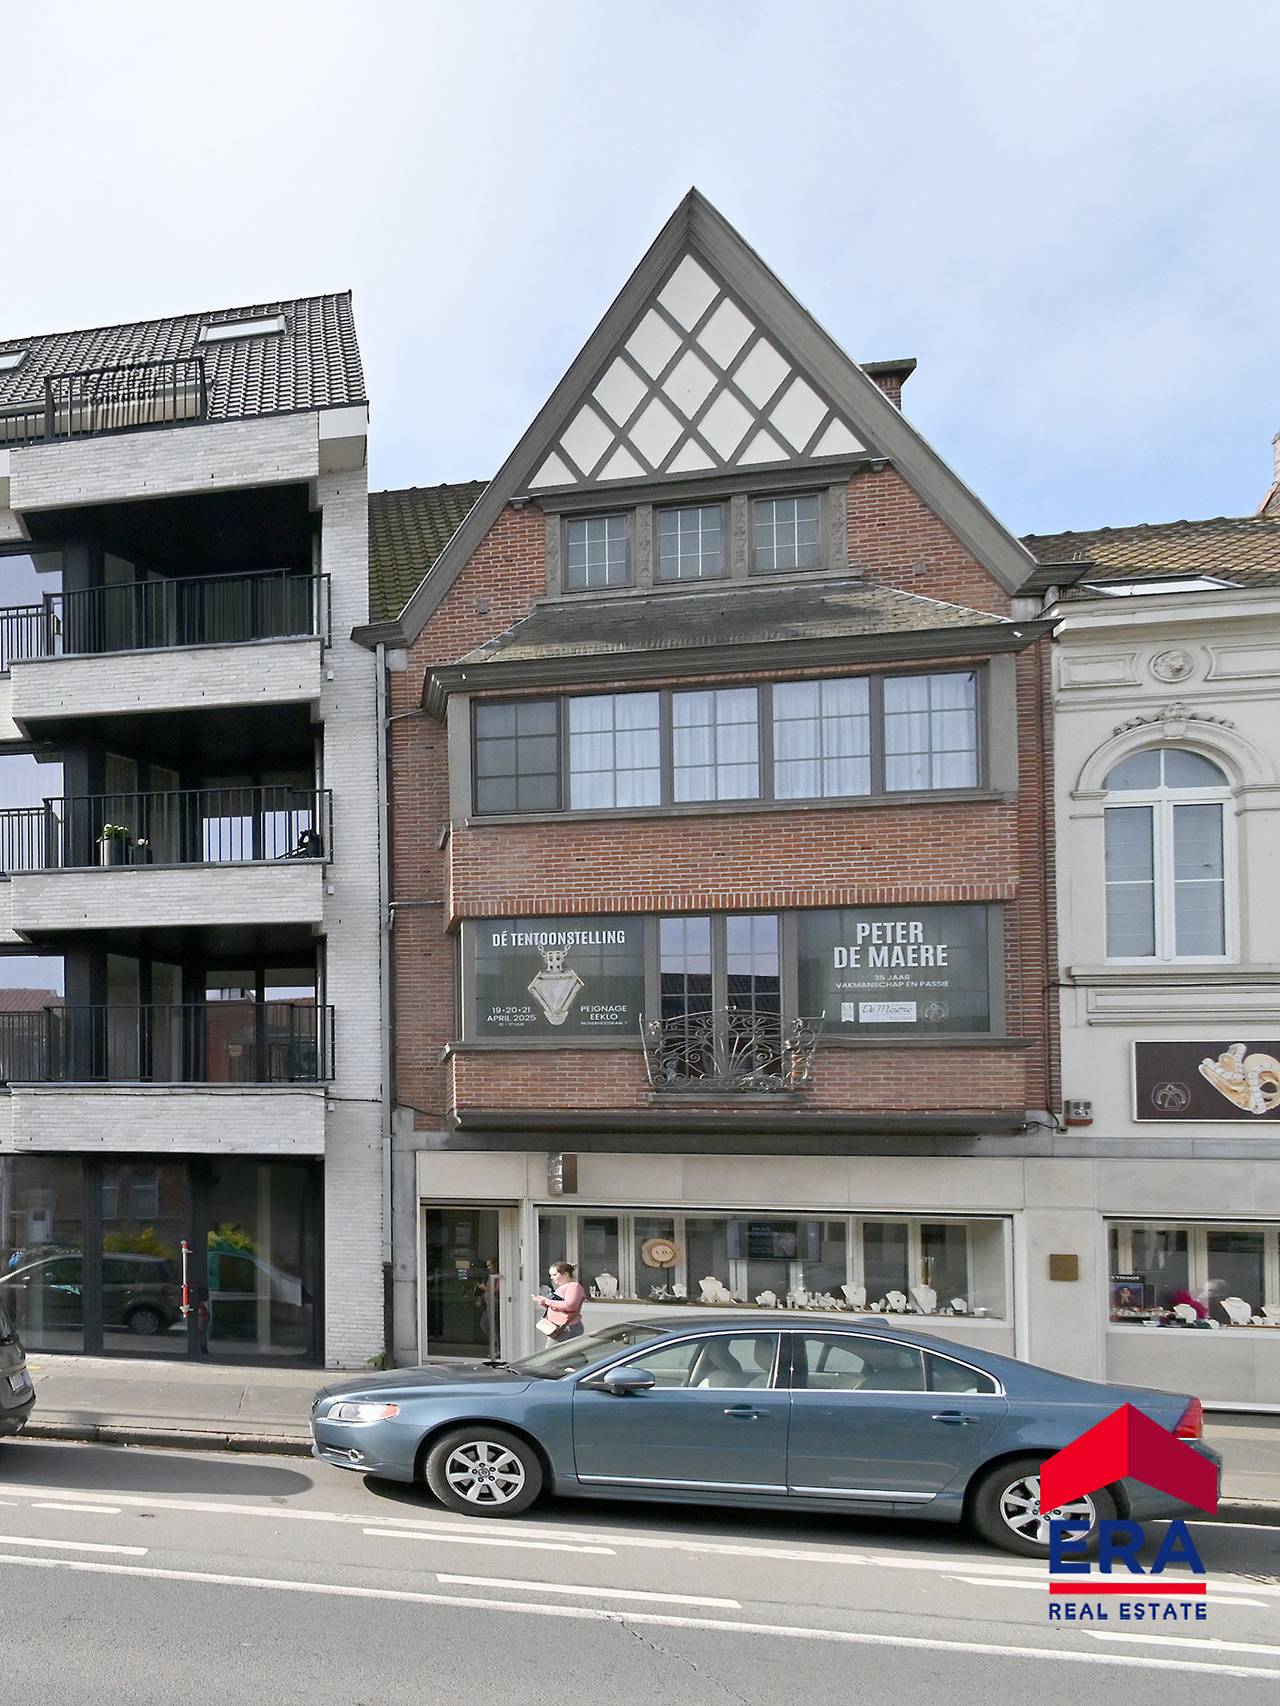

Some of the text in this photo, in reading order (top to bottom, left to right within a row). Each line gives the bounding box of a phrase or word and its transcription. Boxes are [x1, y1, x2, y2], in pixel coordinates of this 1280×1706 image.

[492, 930, 625, 947] DÉ TENTOONSTELLING
[856, 921, 924, 944] PETER
[833, 944, 948, 968] DE MAERE
[835, 981, 904, 989] VAKMANSCHAP
[486, 1014, 537, 1022] APRIL 2025
[590, 1013, 619, 1021] EEKLO
